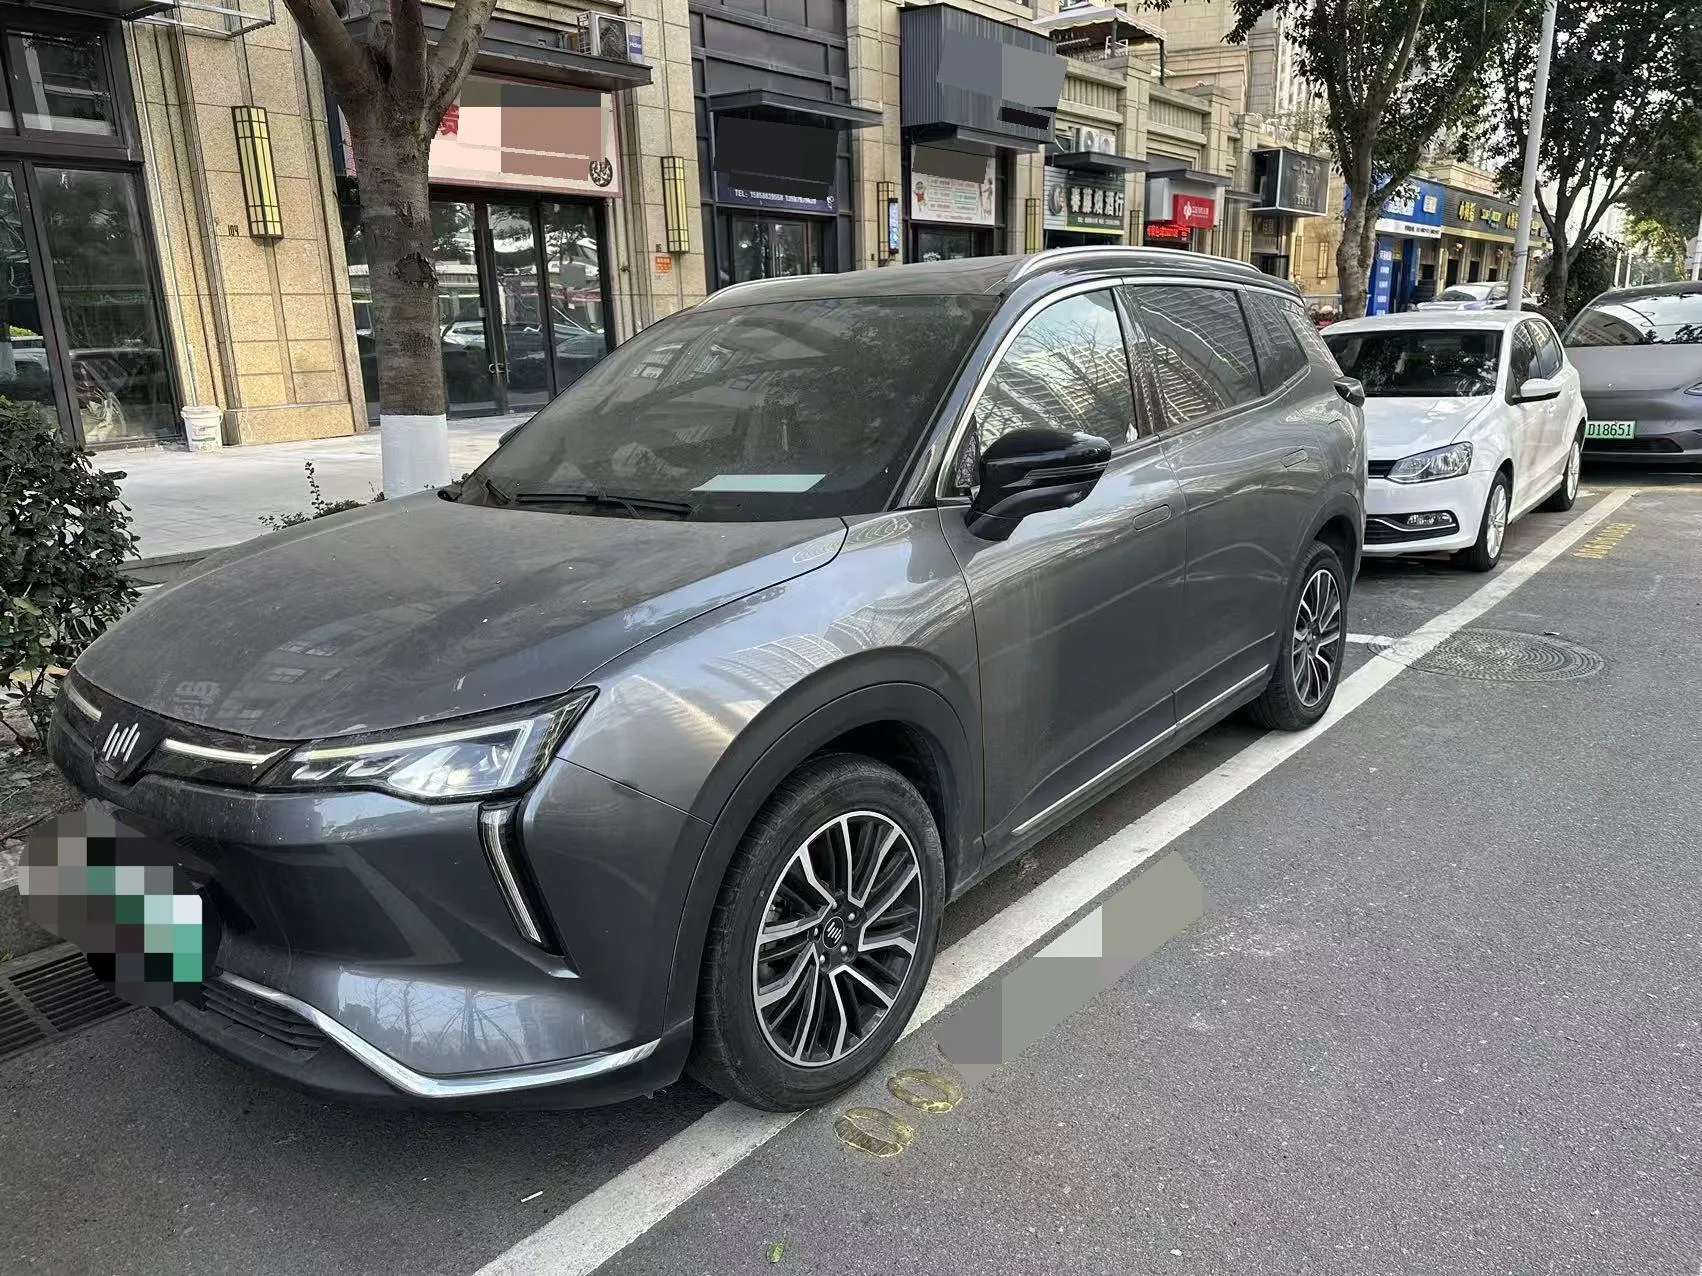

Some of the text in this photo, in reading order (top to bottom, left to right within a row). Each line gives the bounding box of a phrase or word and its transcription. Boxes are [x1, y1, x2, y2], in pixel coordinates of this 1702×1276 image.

[734, 188, 748, 198] TEL:
[227, 224, 240, 236] 104
[1587, 423, 1632, 437] D18651
